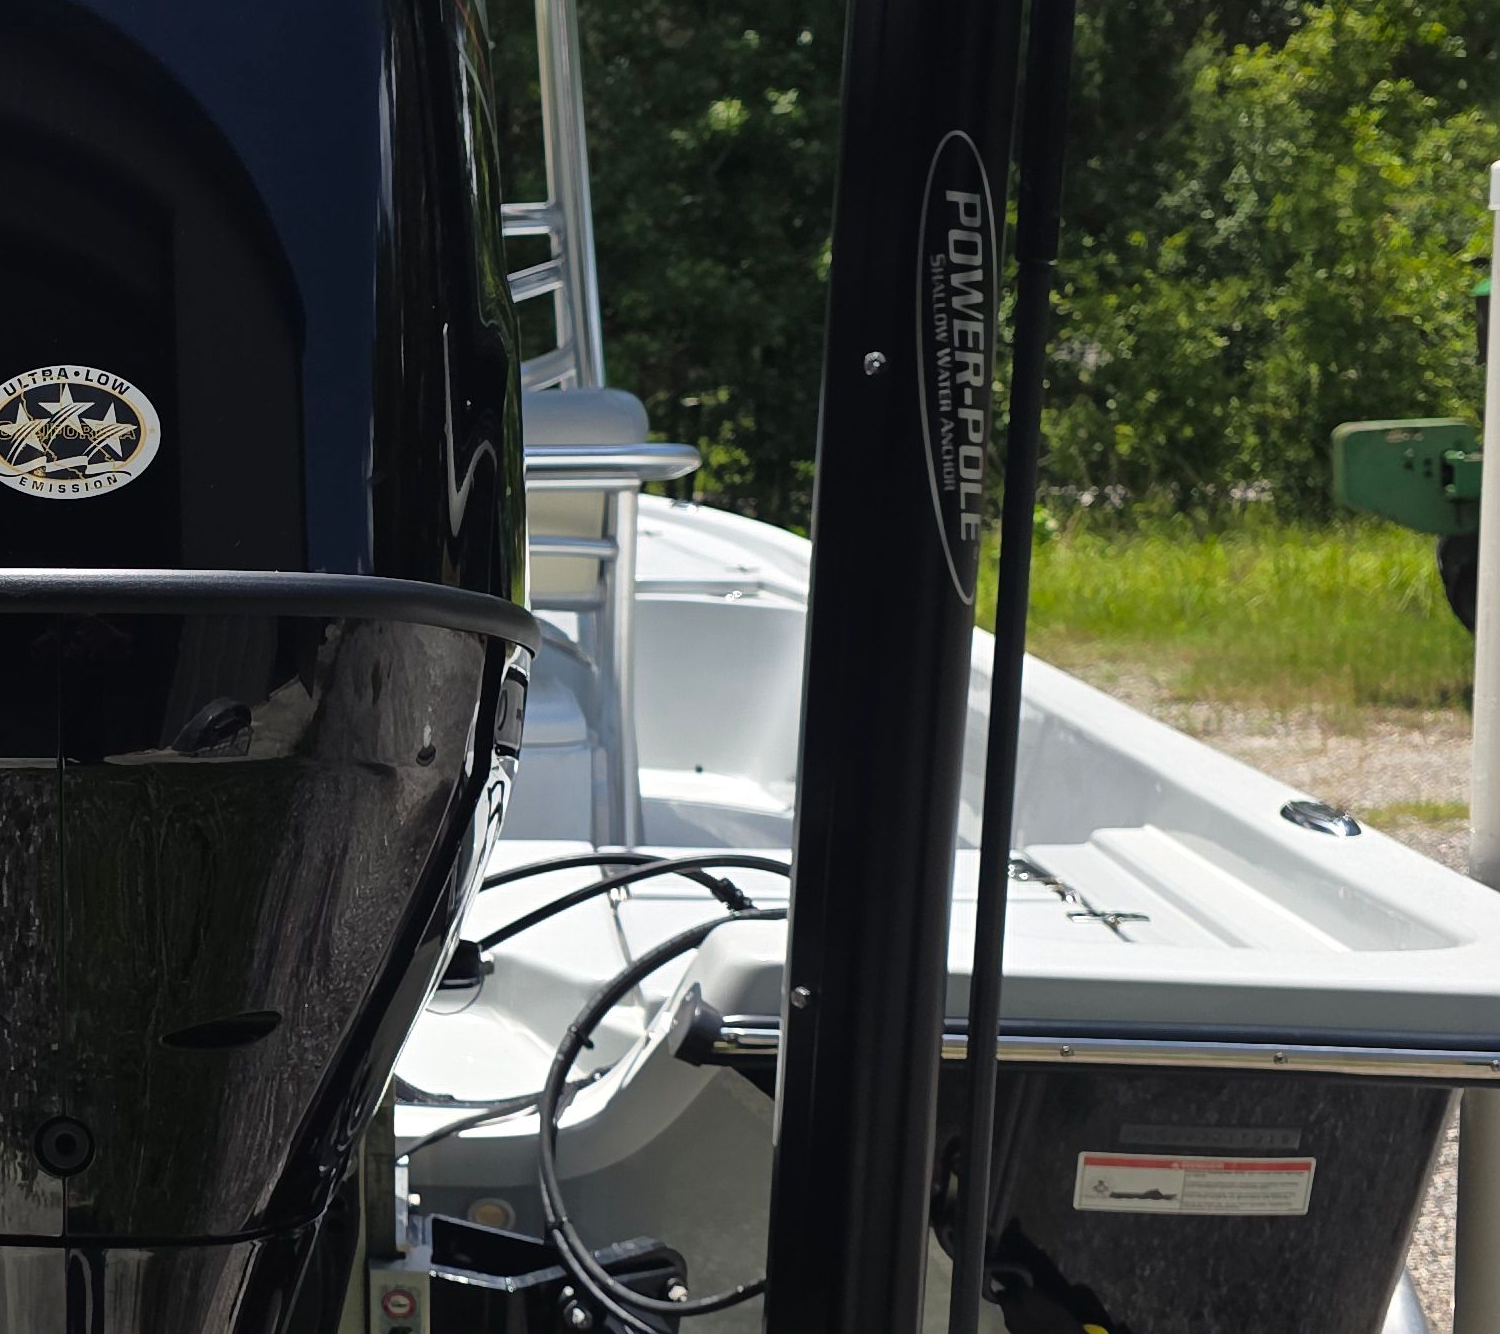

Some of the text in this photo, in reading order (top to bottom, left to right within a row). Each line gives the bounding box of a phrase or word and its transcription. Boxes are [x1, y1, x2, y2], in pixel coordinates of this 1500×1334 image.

[2, 367, 131, 398] ULTRA LOW
[929, 253, 956, 492] SHALLOW WATER ANCHOR
[945, 190, 984, 542] POWER-POLE
[18, 473, 118, 495] EMISSION
